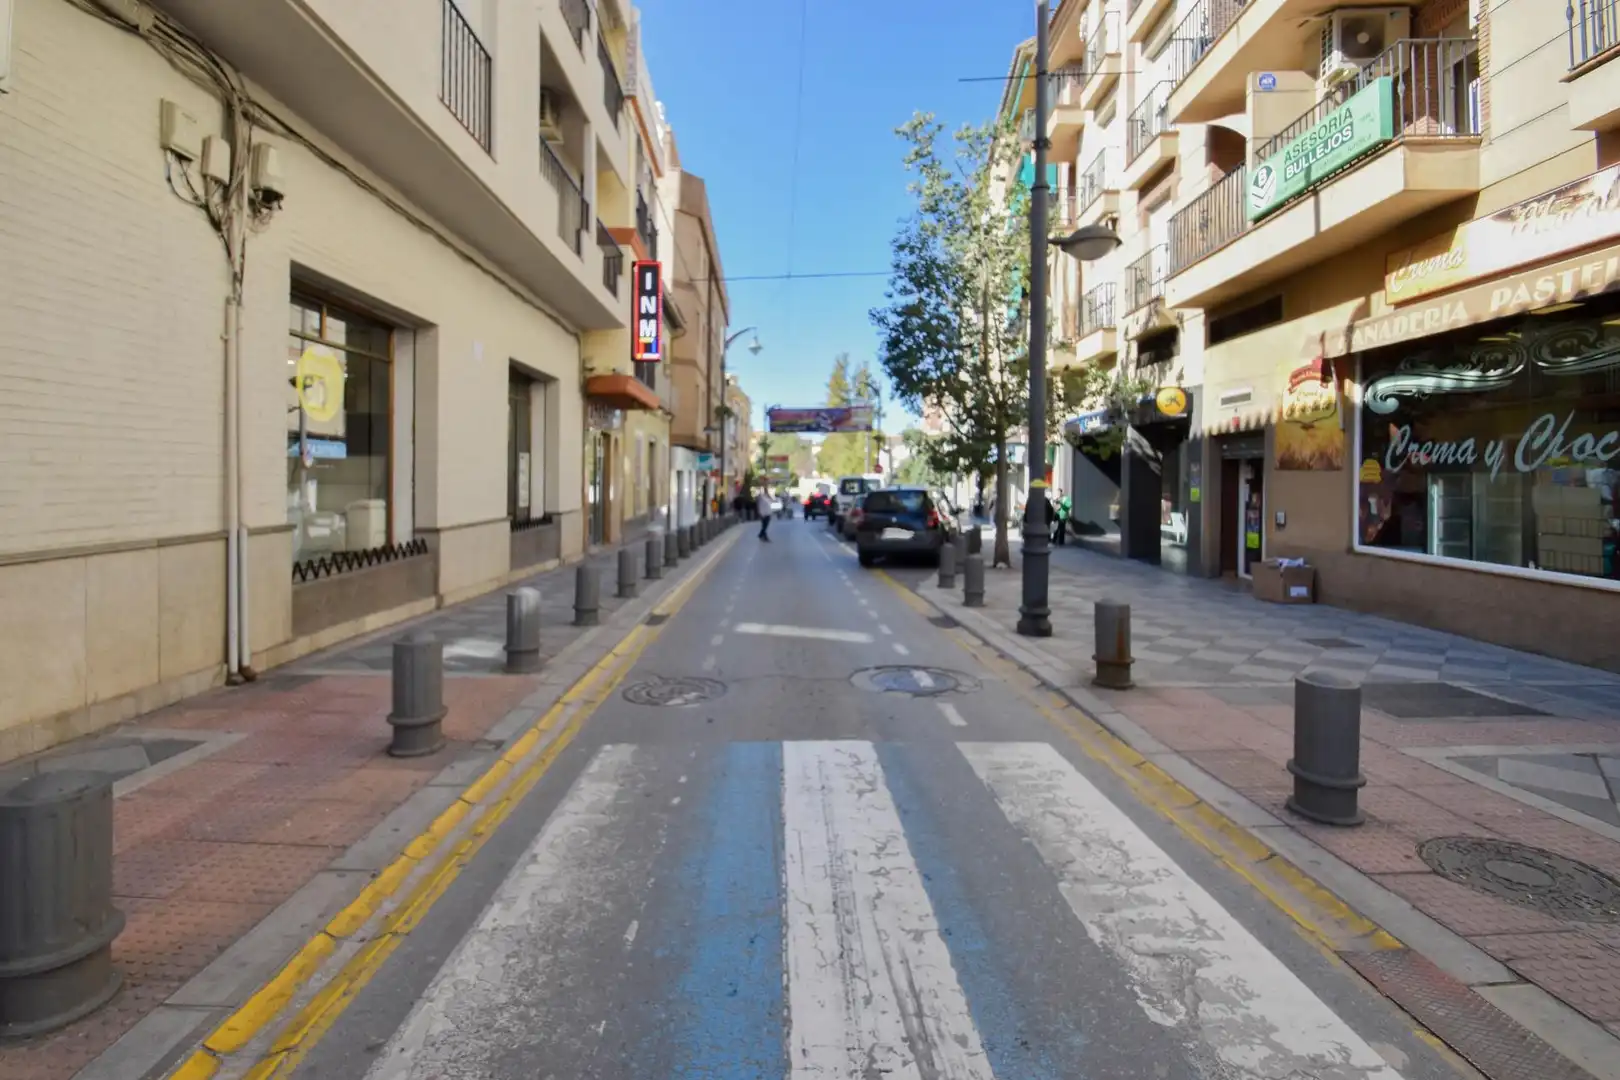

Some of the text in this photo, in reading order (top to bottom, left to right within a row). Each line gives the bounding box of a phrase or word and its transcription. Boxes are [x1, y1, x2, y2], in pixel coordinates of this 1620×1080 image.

[1286, 126, 1353, 179] BULLEJOS
[1338, 301, 1468, 351] ANADERIA
[1385, 424, 1478, 473] Crema
[1484, 438, 1505, 483] y
